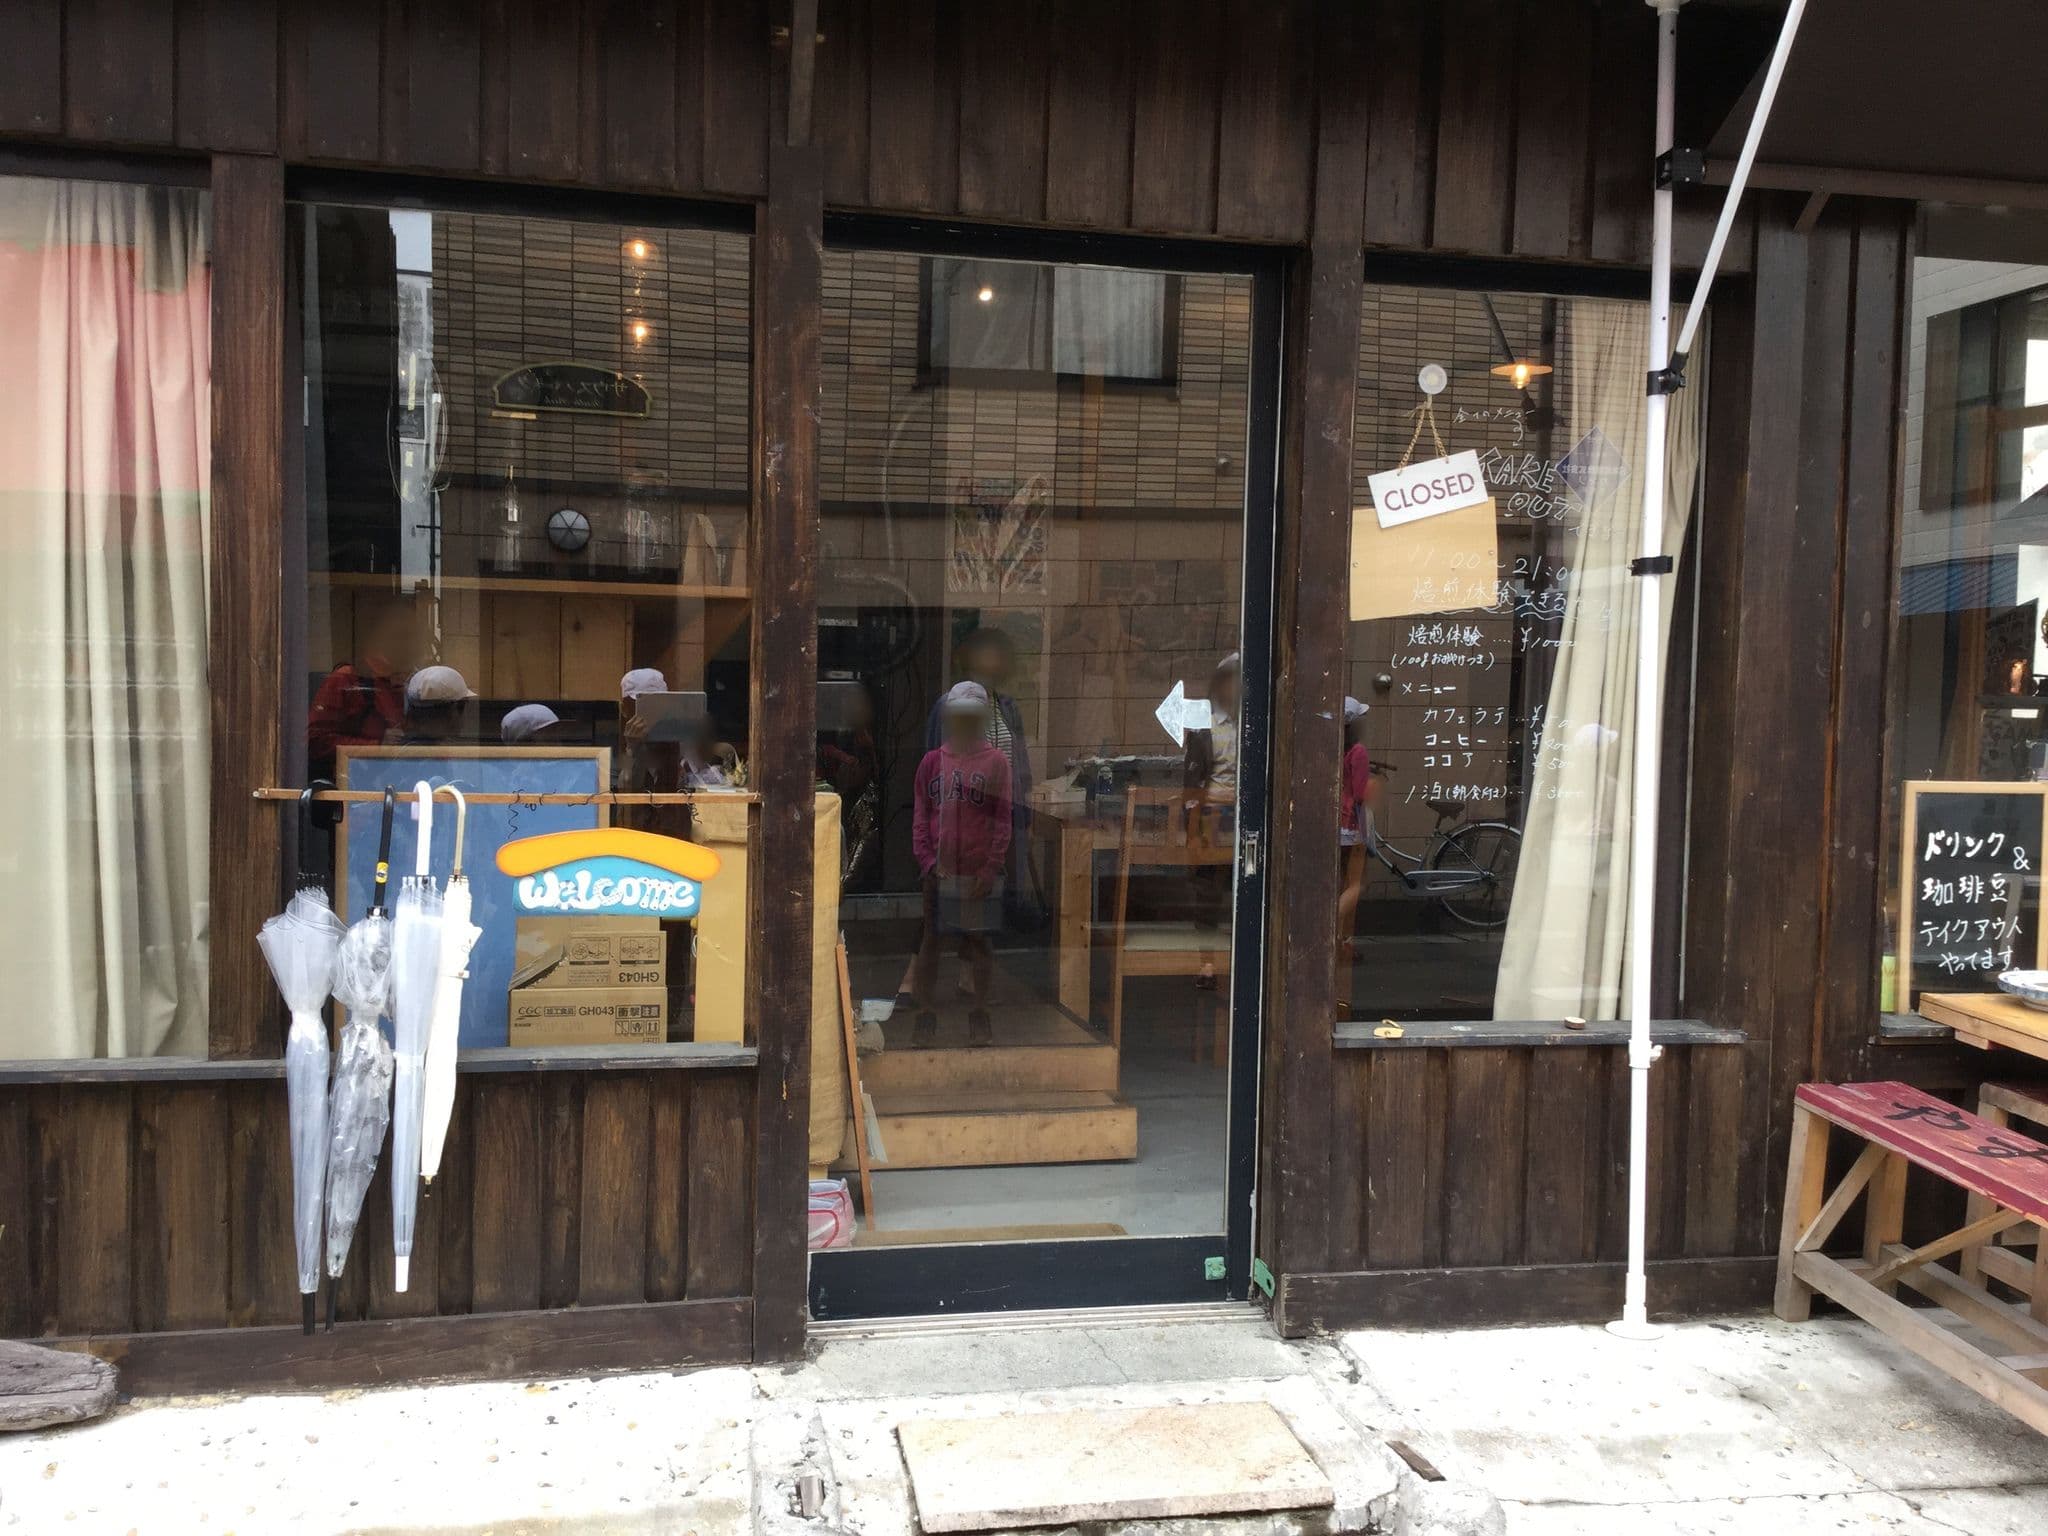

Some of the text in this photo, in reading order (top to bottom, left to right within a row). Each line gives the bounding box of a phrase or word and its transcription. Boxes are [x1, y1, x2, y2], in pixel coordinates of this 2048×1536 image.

[1478, 447, 1556, 493] TAKE
[1384, 473, 1475, 511] CLOSED
[1507, 492, 1584, 520] OUT
[1407, 623, 1485, 648] 焙煎体験
[1402, 682, 1457, 695] メニュー
[1423, 707, 1505, 725] カフェラテ
[1425, 734, 1488, 746] コーヒー
[1424, 752, 1474, 768] ココア
[1924, 830, 2031, 870] ドリンク &
[1922, 873, 2008, 906] 珈琲豆
[619, 972, 659, 983] GH043
[518, 1006, 542, 1015] CGC
[578, 1007, 615, 1016] GH043
